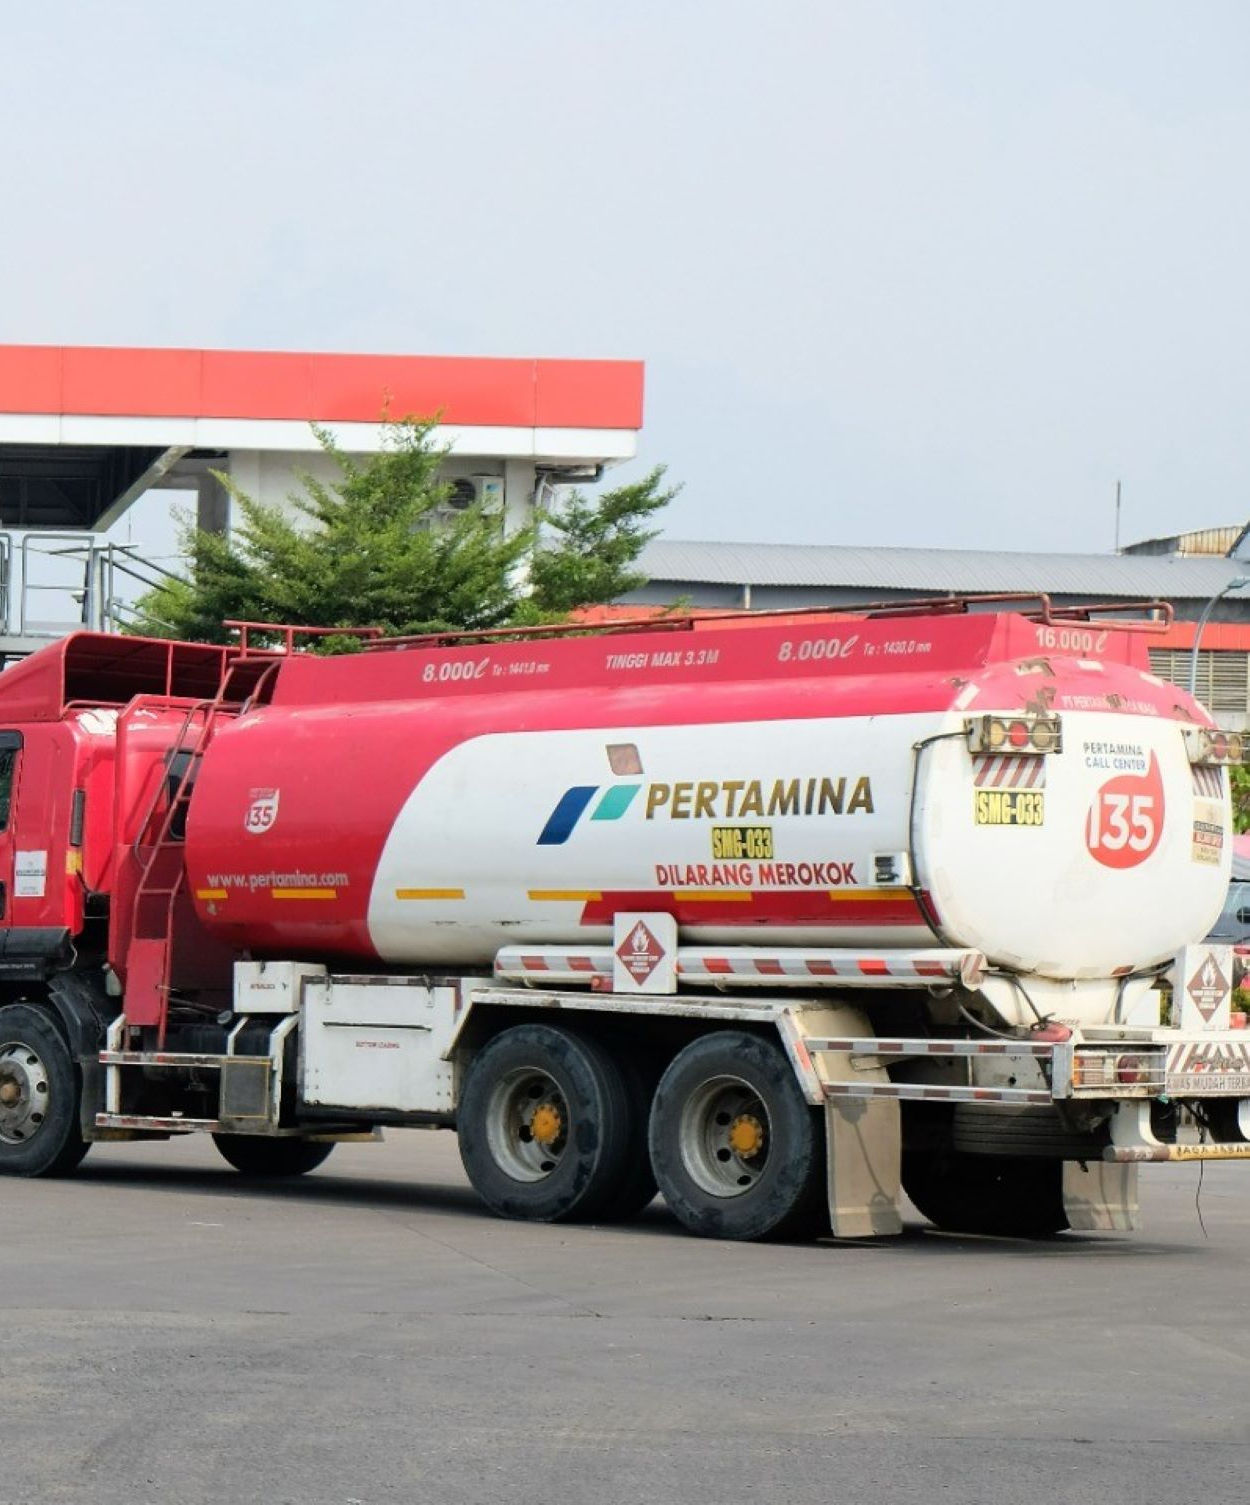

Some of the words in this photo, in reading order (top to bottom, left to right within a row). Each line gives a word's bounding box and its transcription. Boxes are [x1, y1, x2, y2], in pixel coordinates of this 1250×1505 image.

[606, 653, 649, 670] TINGGI
[651, 651, 682, 667] MAX
[1083, 742, 1144, 756] PERTAMINA
[1085, 757, 1111, 769] CALL
[1113, 759, 1147, 771] CENTER
[646, 776, 875, 820] PERTAMINA
[978, 791, 1043, 825] SMG-033
[246, 806, 273, 826] 135
[1089, 793, 1155, 852] 135
[713, 828, 772, 858] SMG-033
[207, 869, 349, 893] www.pertamina.com
[656, 864, 753, 886] DILARANG
[759, 862, 859, 885] MEROKOK
